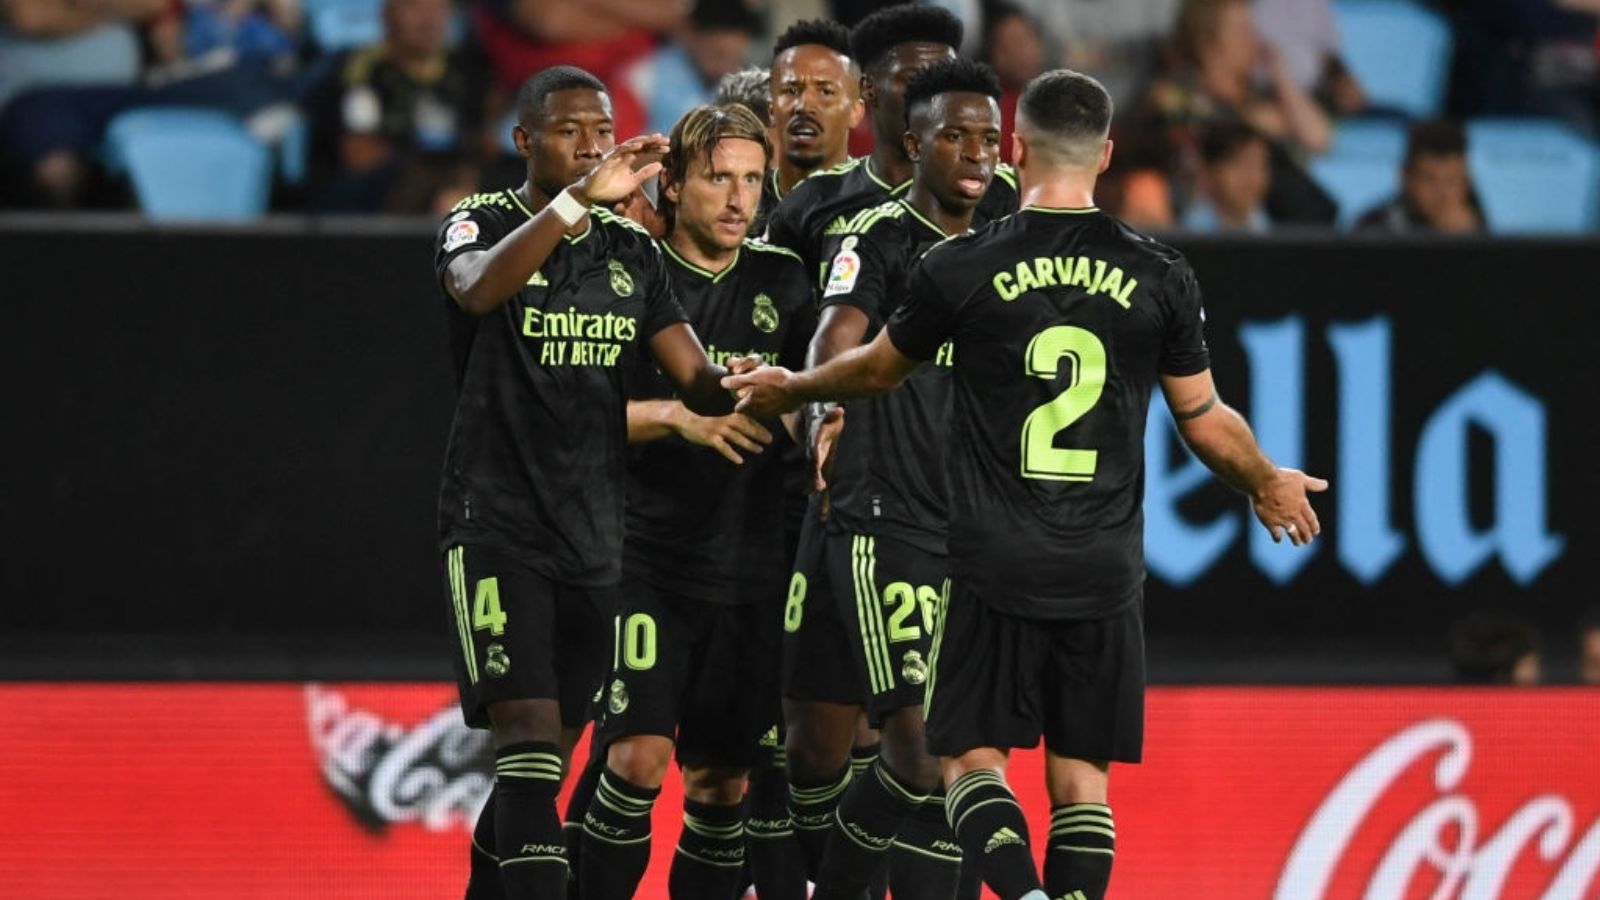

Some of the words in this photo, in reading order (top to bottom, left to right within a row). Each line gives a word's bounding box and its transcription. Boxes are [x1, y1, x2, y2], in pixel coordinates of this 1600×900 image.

[993, 256, 1138, 310] CARVAJAL
[523, 306, 636, 341] Emirates
[541, 341, 567, 366] FLY
[570, 341, 622, 367] BETTER
[1020, 325, 1107, 482] 2
[473, 577, 507, 636] 4
